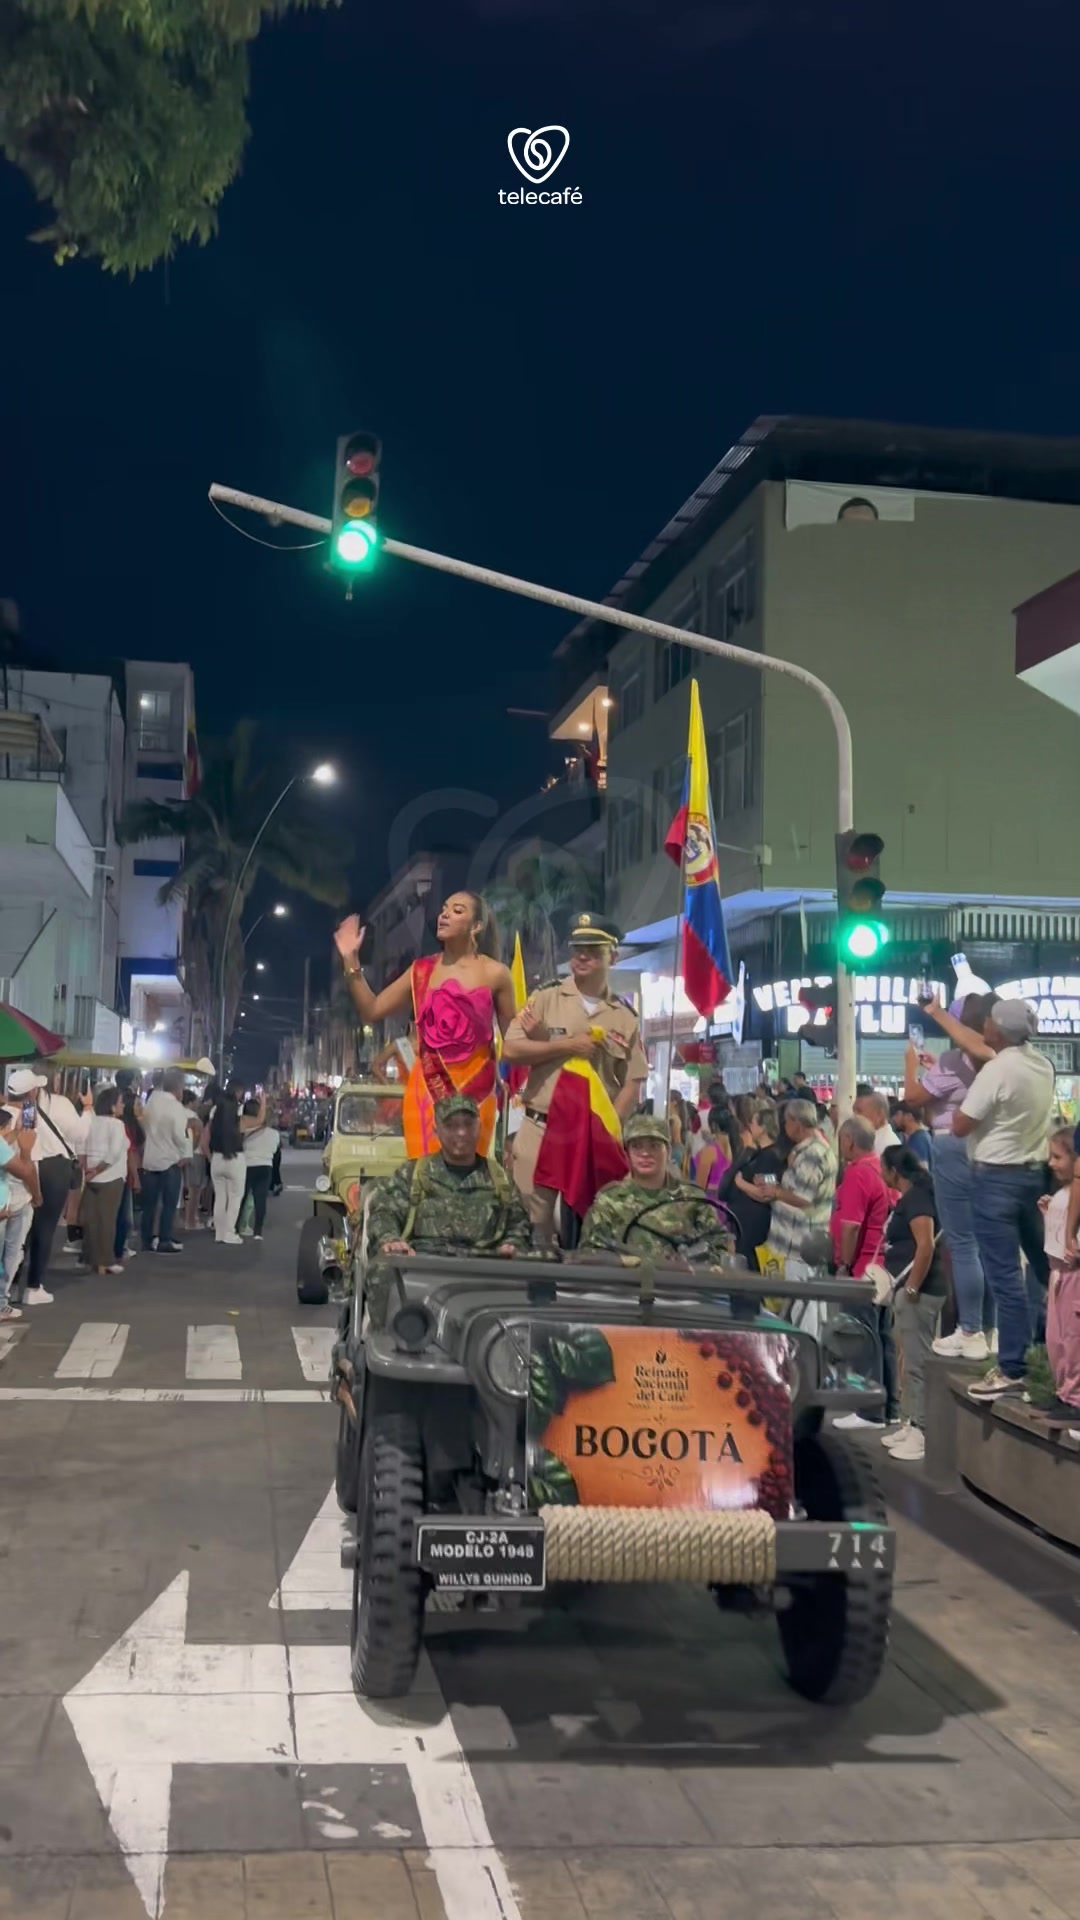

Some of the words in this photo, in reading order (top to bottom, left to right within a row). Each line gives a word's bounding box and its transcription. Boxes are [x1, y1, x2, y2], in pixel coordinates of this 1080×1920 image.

[786, 1005, 906, 1034] PALU
[635, 1365, 689, 1379] Reinado
[634, 1377, 689, 1391] Nacional
[636, 1389, 655, 1401] del
[575, 1422, 744, 1464] BOGOTÁ
[430, 1543, 495, 1558] MODELO
[438, 1572, 480, 1585] WILLYS
